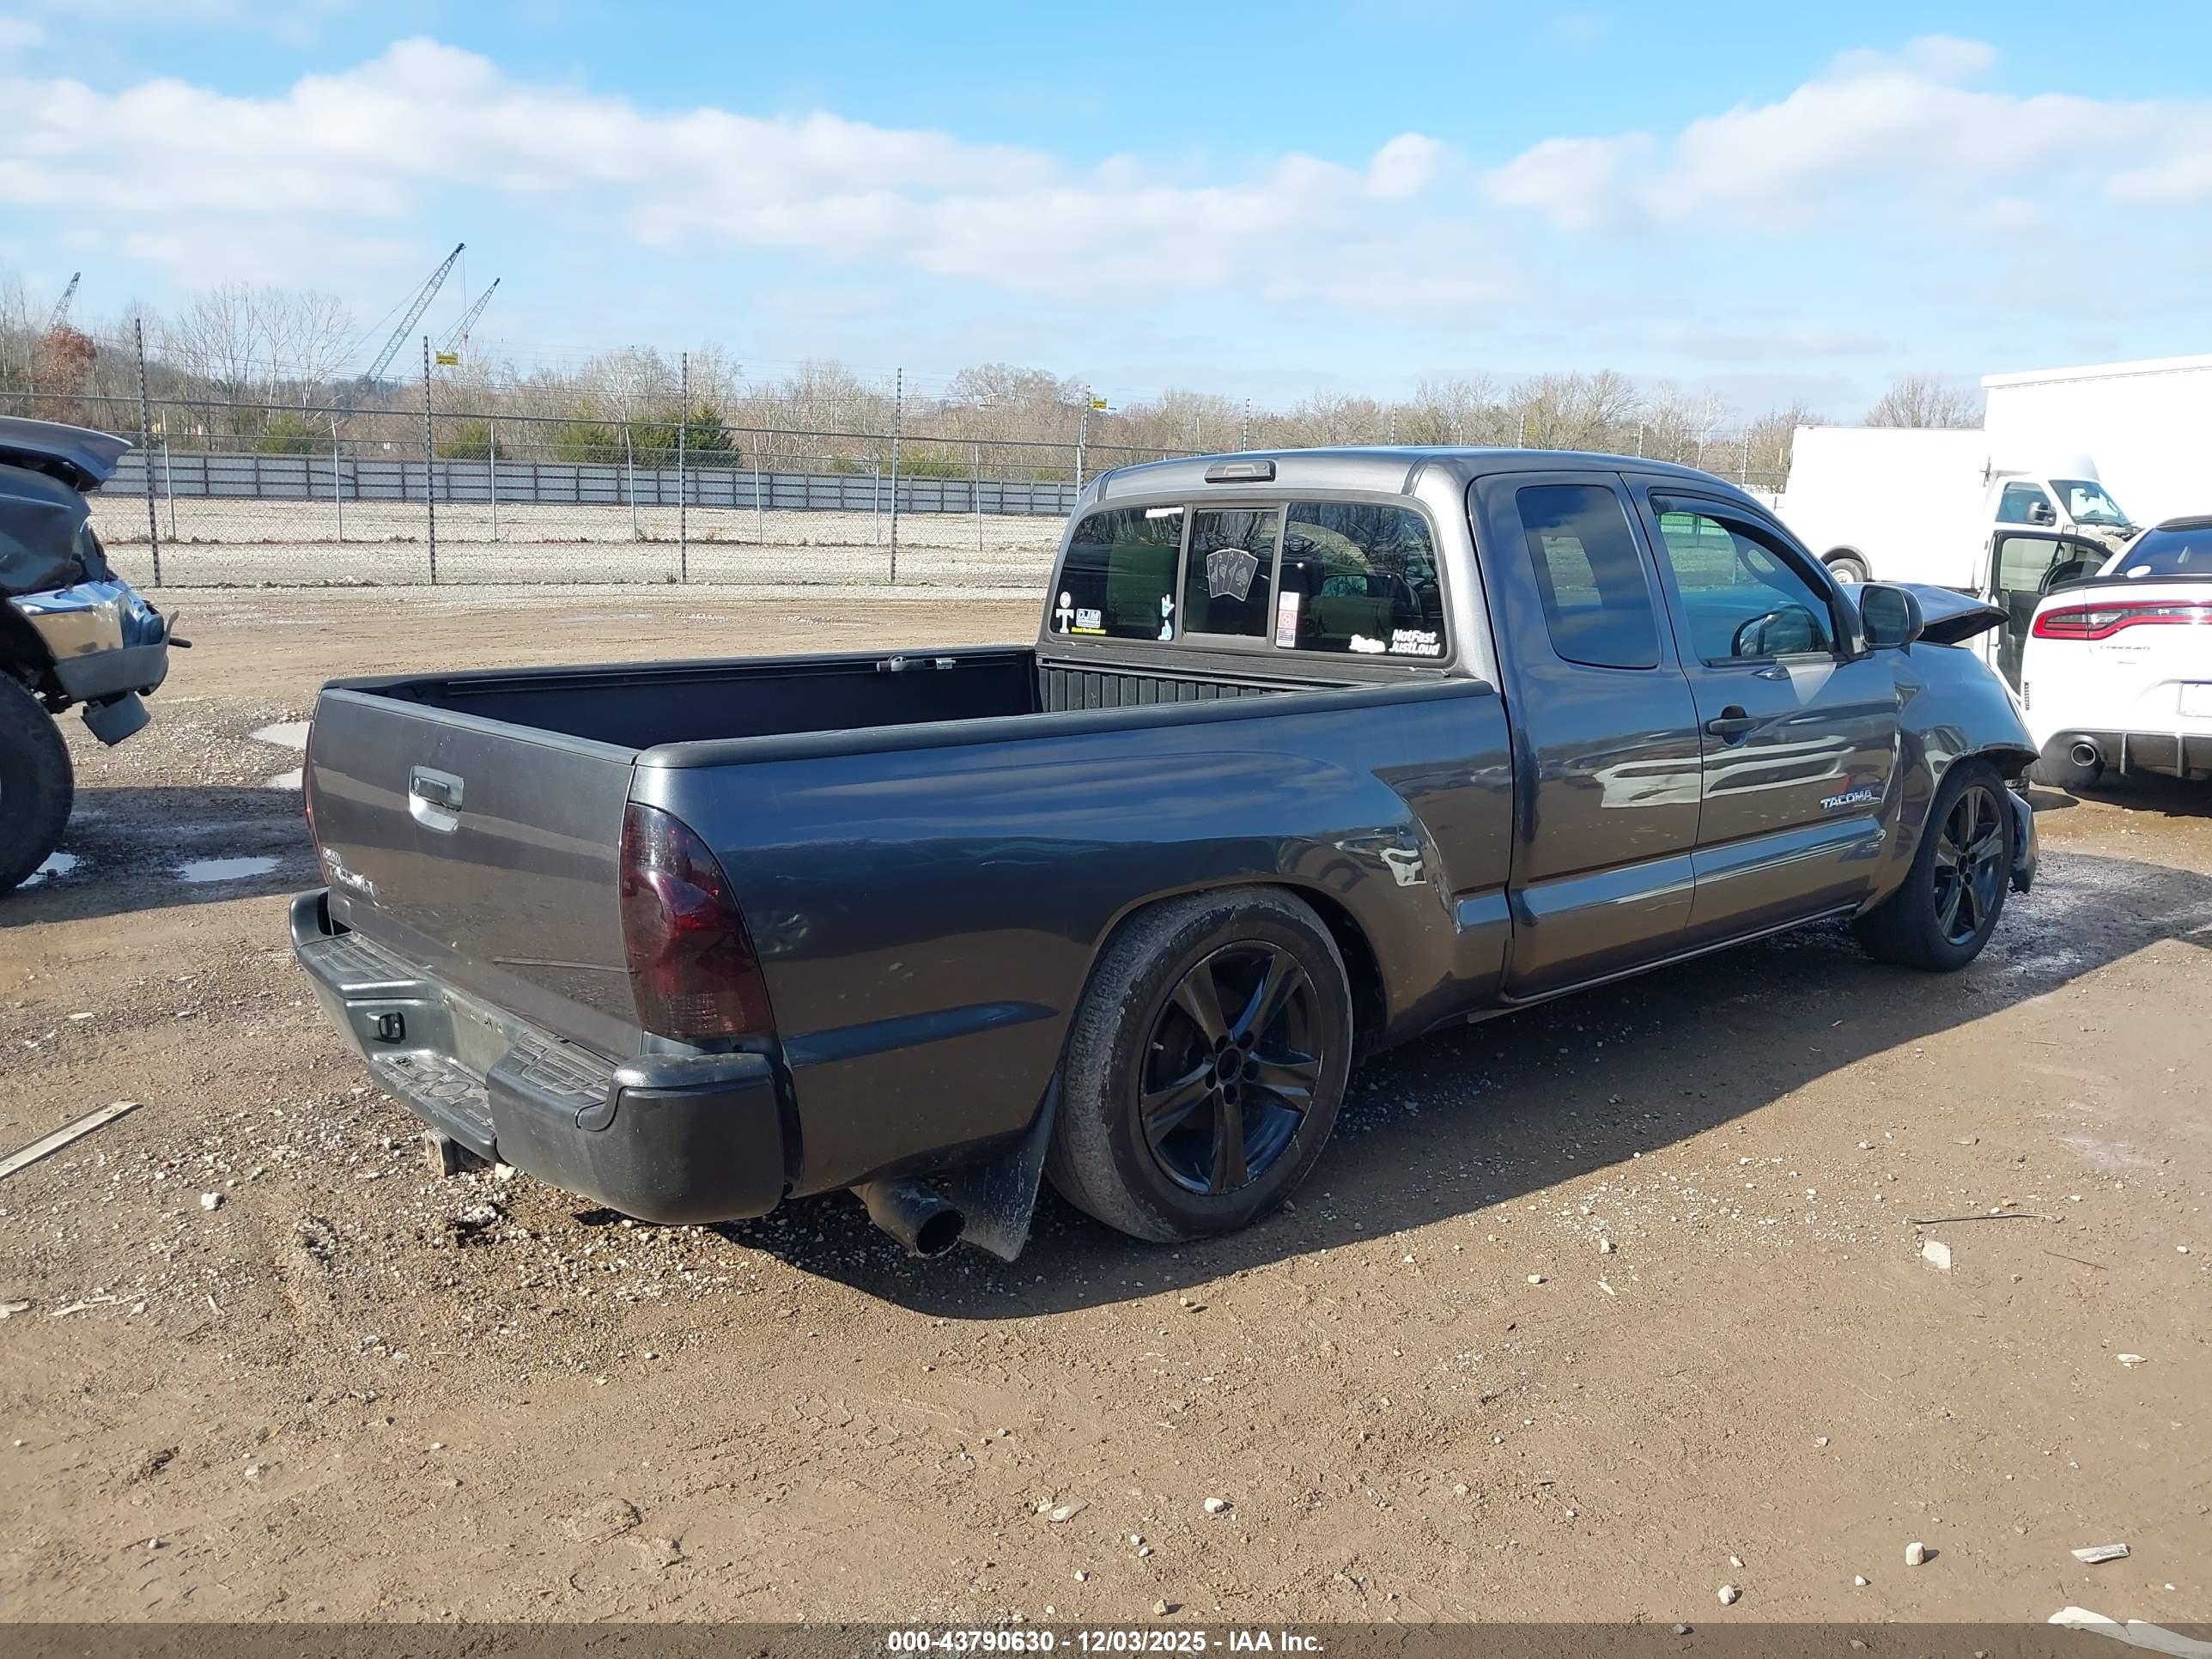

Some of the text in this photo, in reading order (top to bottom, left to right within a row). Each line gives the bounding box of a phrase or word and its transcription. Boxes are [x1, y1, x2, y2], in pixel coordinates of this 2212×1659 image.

[1055, 609, 1074, 634] T
[1392, 629, 1437, 643] NotFast
[1389, 641, 1441, 656] JustLoud
[1820, 789, 1874, 810] TACOMA
